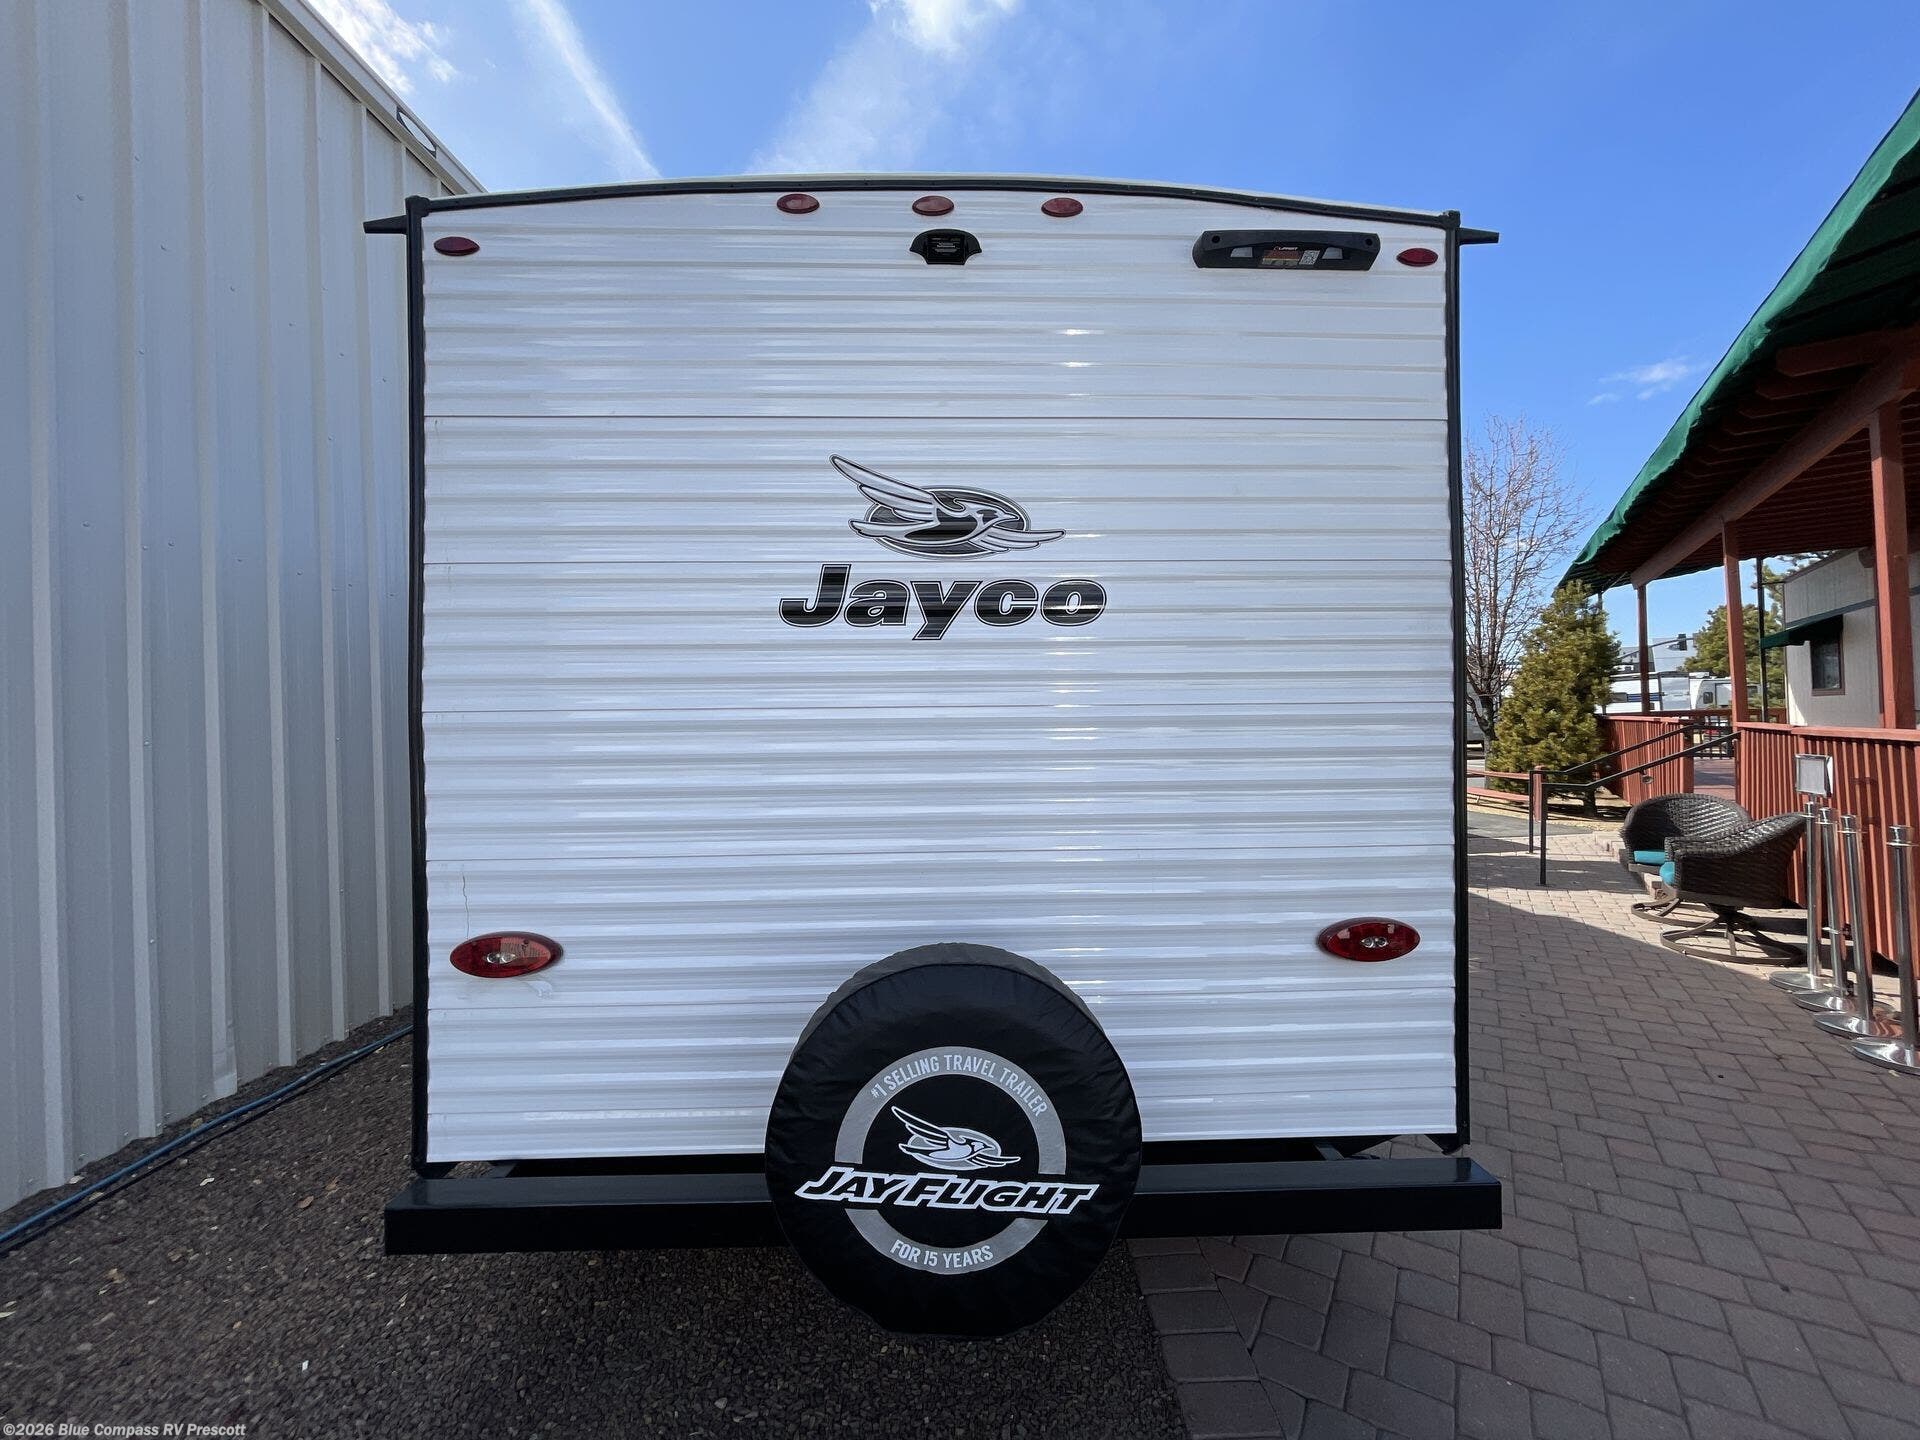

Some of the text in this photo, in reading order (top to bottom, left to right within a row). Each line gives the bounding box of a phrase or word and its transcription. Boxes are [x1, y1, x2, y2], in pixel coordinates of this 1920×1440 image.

[779, 563, 1107, 641] Jayco
[870, 1054, 1048, 1117] #1 SELLING TRAVEL TRAILER
[889, 1239, 994, 1268] FOR 15 YEARS
